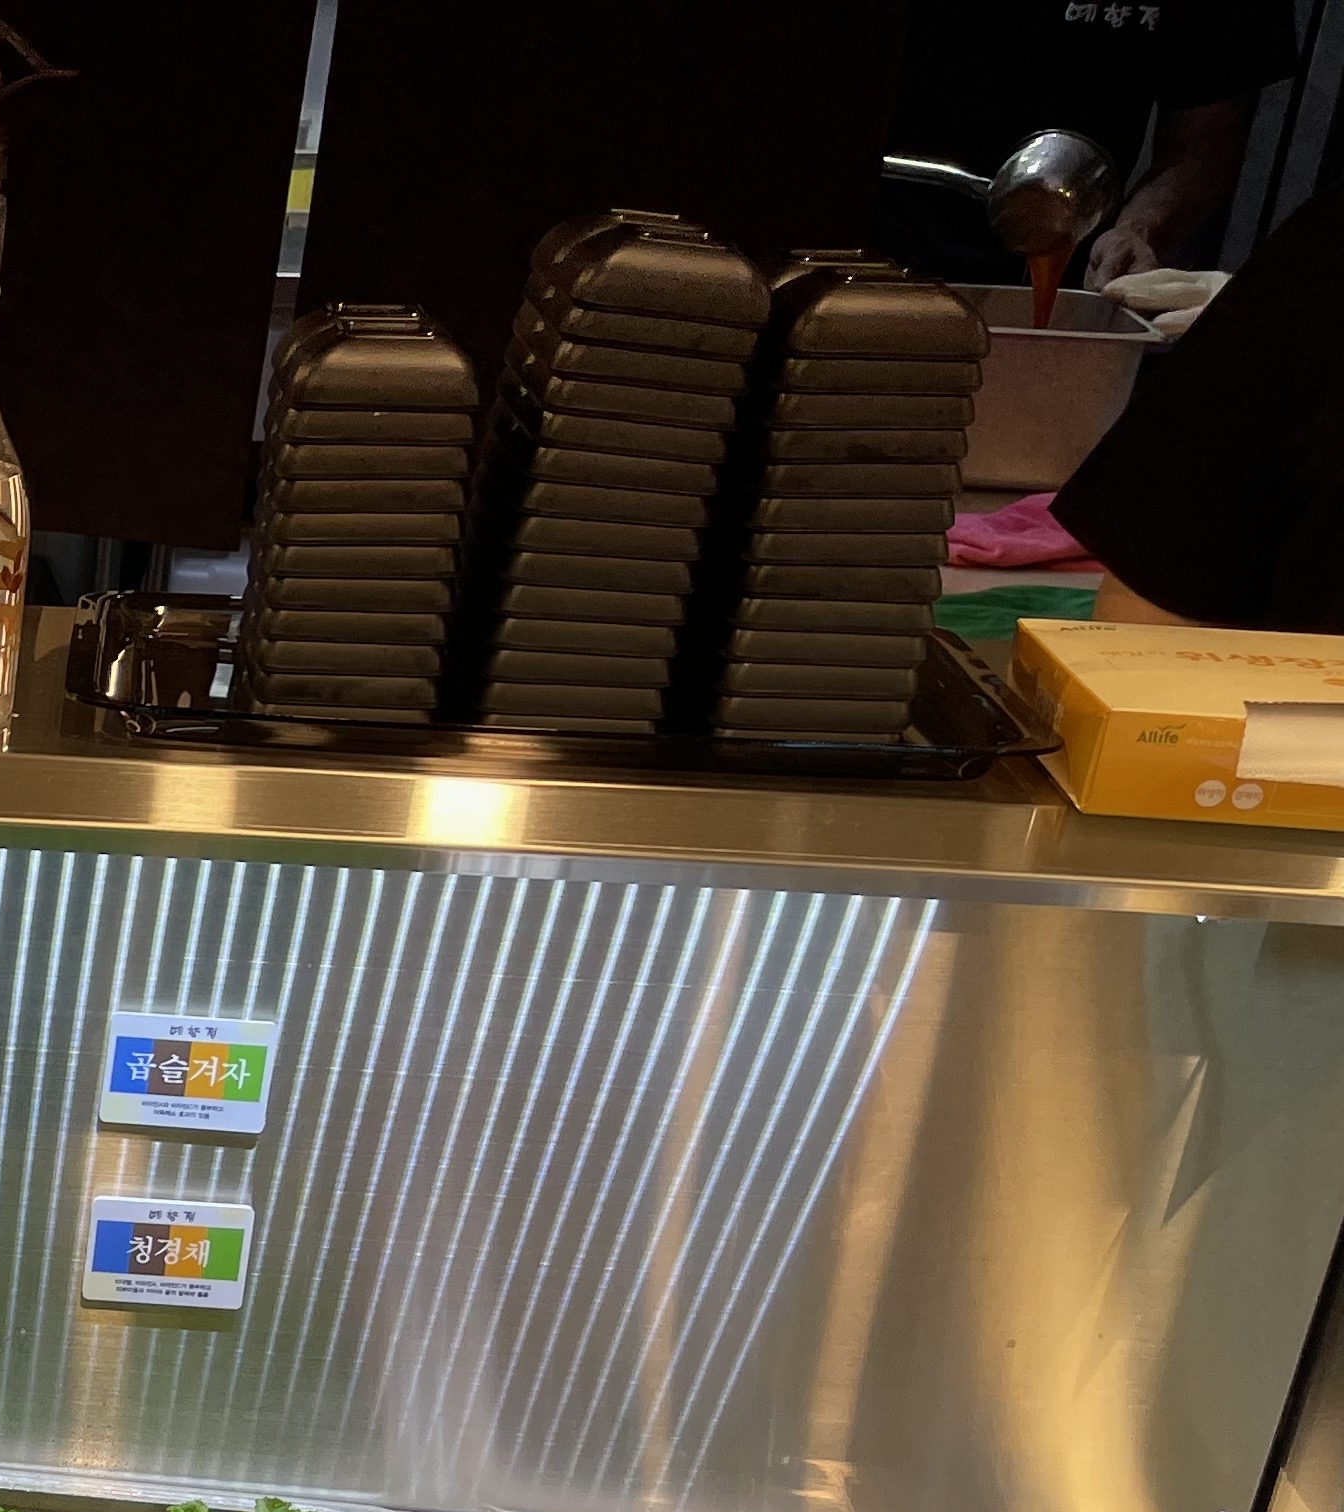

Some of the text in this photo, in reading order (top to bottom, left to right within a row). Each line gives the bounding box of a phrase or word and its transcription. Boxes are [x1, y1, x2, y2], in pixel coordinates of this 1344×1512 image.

[1136, 729, 1180, 745] Allife
[125, 1049, 252, 1091] 곱슬겨자
[125, 1234, 212, 1269] 청경채
